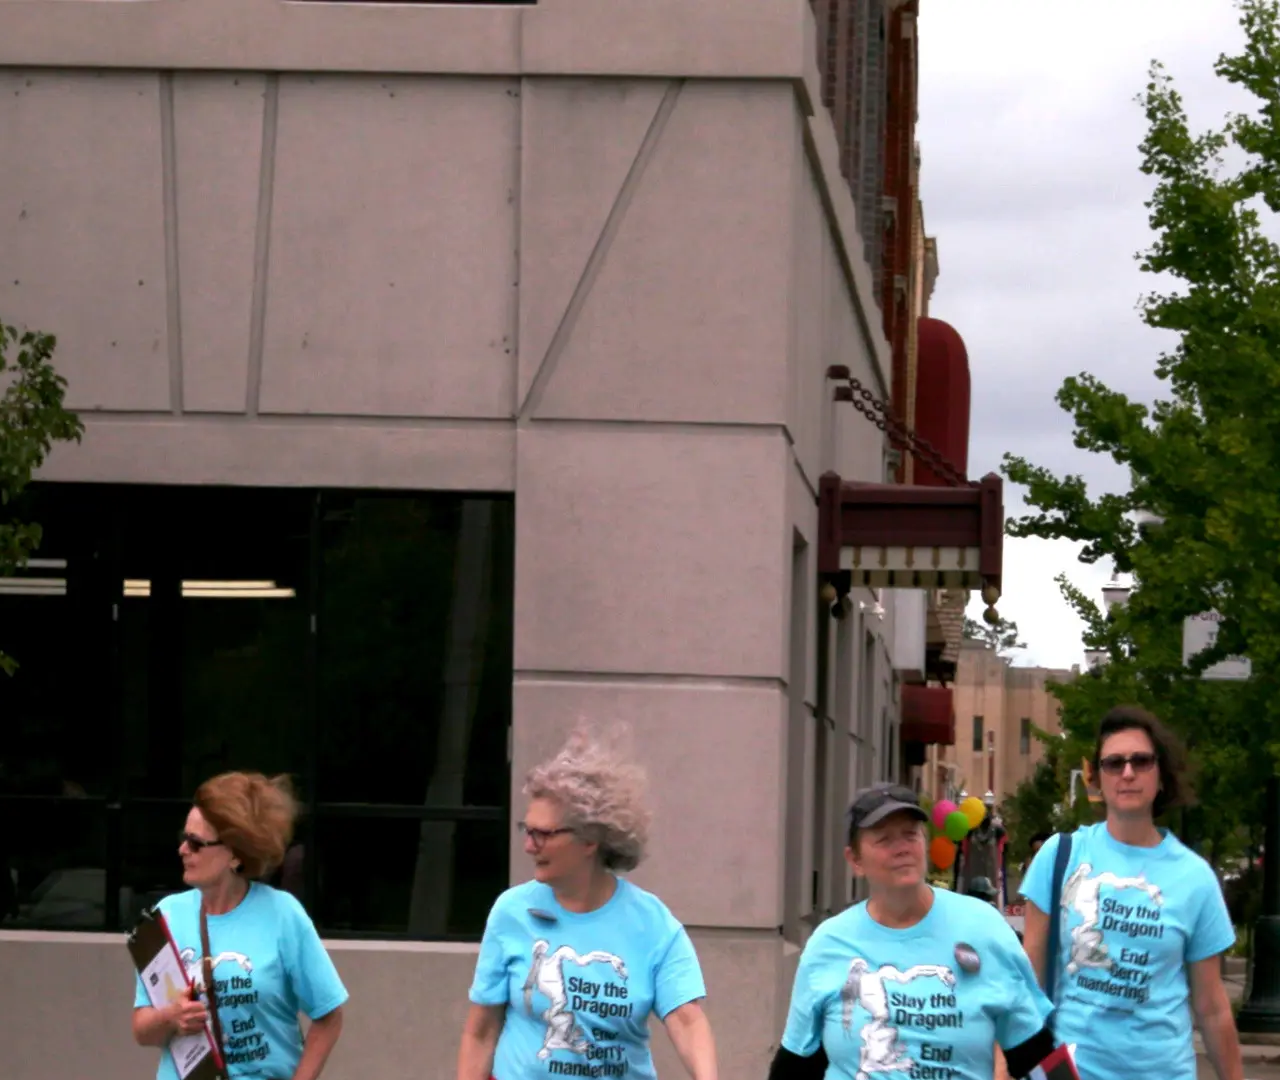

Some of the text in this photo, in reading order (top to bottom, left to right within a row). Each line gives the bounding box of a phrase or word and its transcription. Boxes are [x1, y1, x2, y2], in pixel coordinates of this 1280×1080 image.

[1102, 897, 1160, 921] Slay the
[1101, 915, 1164, 939] Dragon!
[1120, 948, 1149, 966] End
[231, 976, 252, 990] the
[568, 977, 628, 999] Slay the
[572, 995, 633, 1018] Dragon!
[891, 992, 956, 1009] Slay the
[231, 1015, 255, 1033] End
[895, 1009, 962, 1030] Dragon!
[921, 1042, 953, 1062] End
[548, 1059, 629, 1079] mandering!
